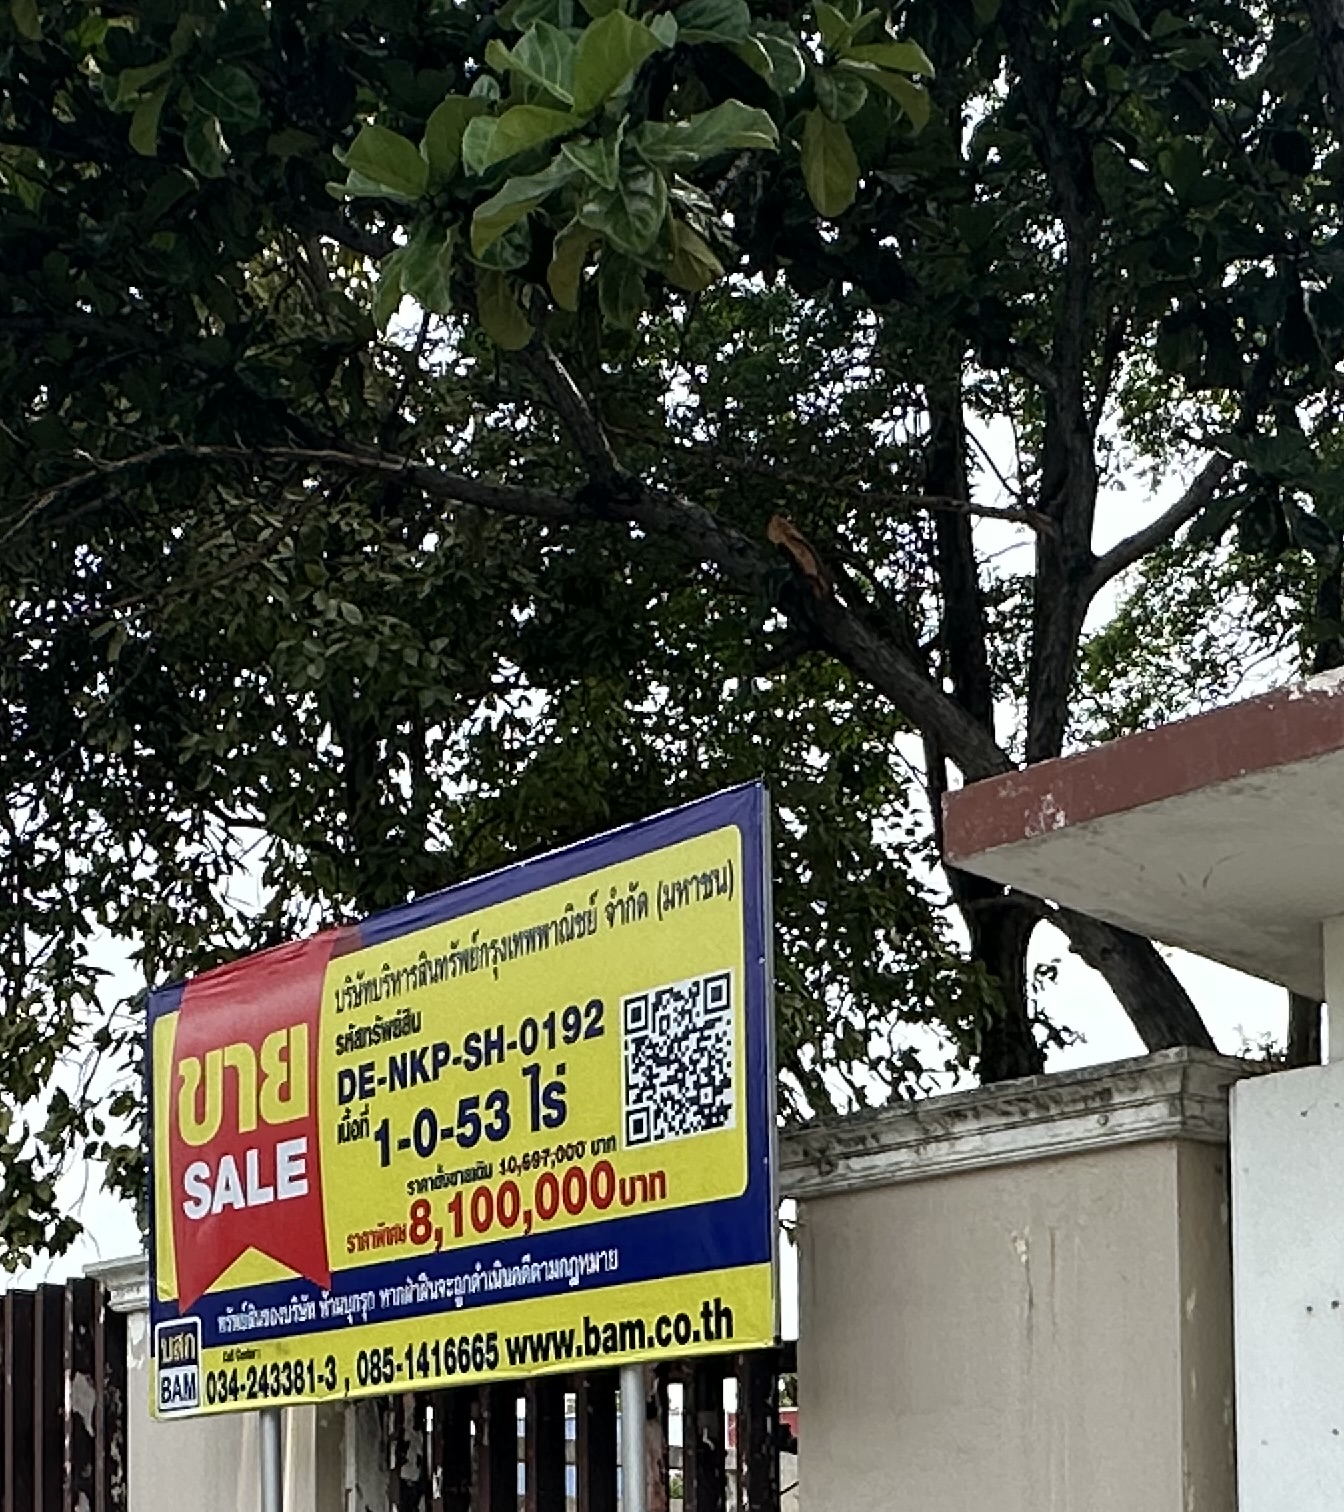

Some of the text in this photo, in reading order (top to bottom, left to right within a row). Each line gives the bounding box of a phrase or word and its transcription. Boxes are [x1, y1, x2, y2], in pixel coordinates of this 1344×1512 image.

[604, 880, 650, 930] จำกัด
[656, 859, 734, 921] (มหาชน)
[335, 1007, 422, 1056] รหัสทรัพย์สิน
[337, 998, 605, 1105] DE-NKP-SH-0192
[178, 1022, 309, 1146] ขาย
[337, 1062, 567, 1168] เนื้อที่ 1-0-53 ไร่
[183, 1136, 308, 1220] SALE
[590, 1135, 617, 1156] บาท
[318, 1290, 375, 1325] ห้ามบุกรุก
[160, 1332, 196, 1362] บสก
[206, 1354, 337, 1405] 034-243381-3
[356, 1330, 499, 1386] 085-1416665
[506, 1297, 734, 1366] www.bam.co.th
[160, 1372, 197, 1404] BAM
